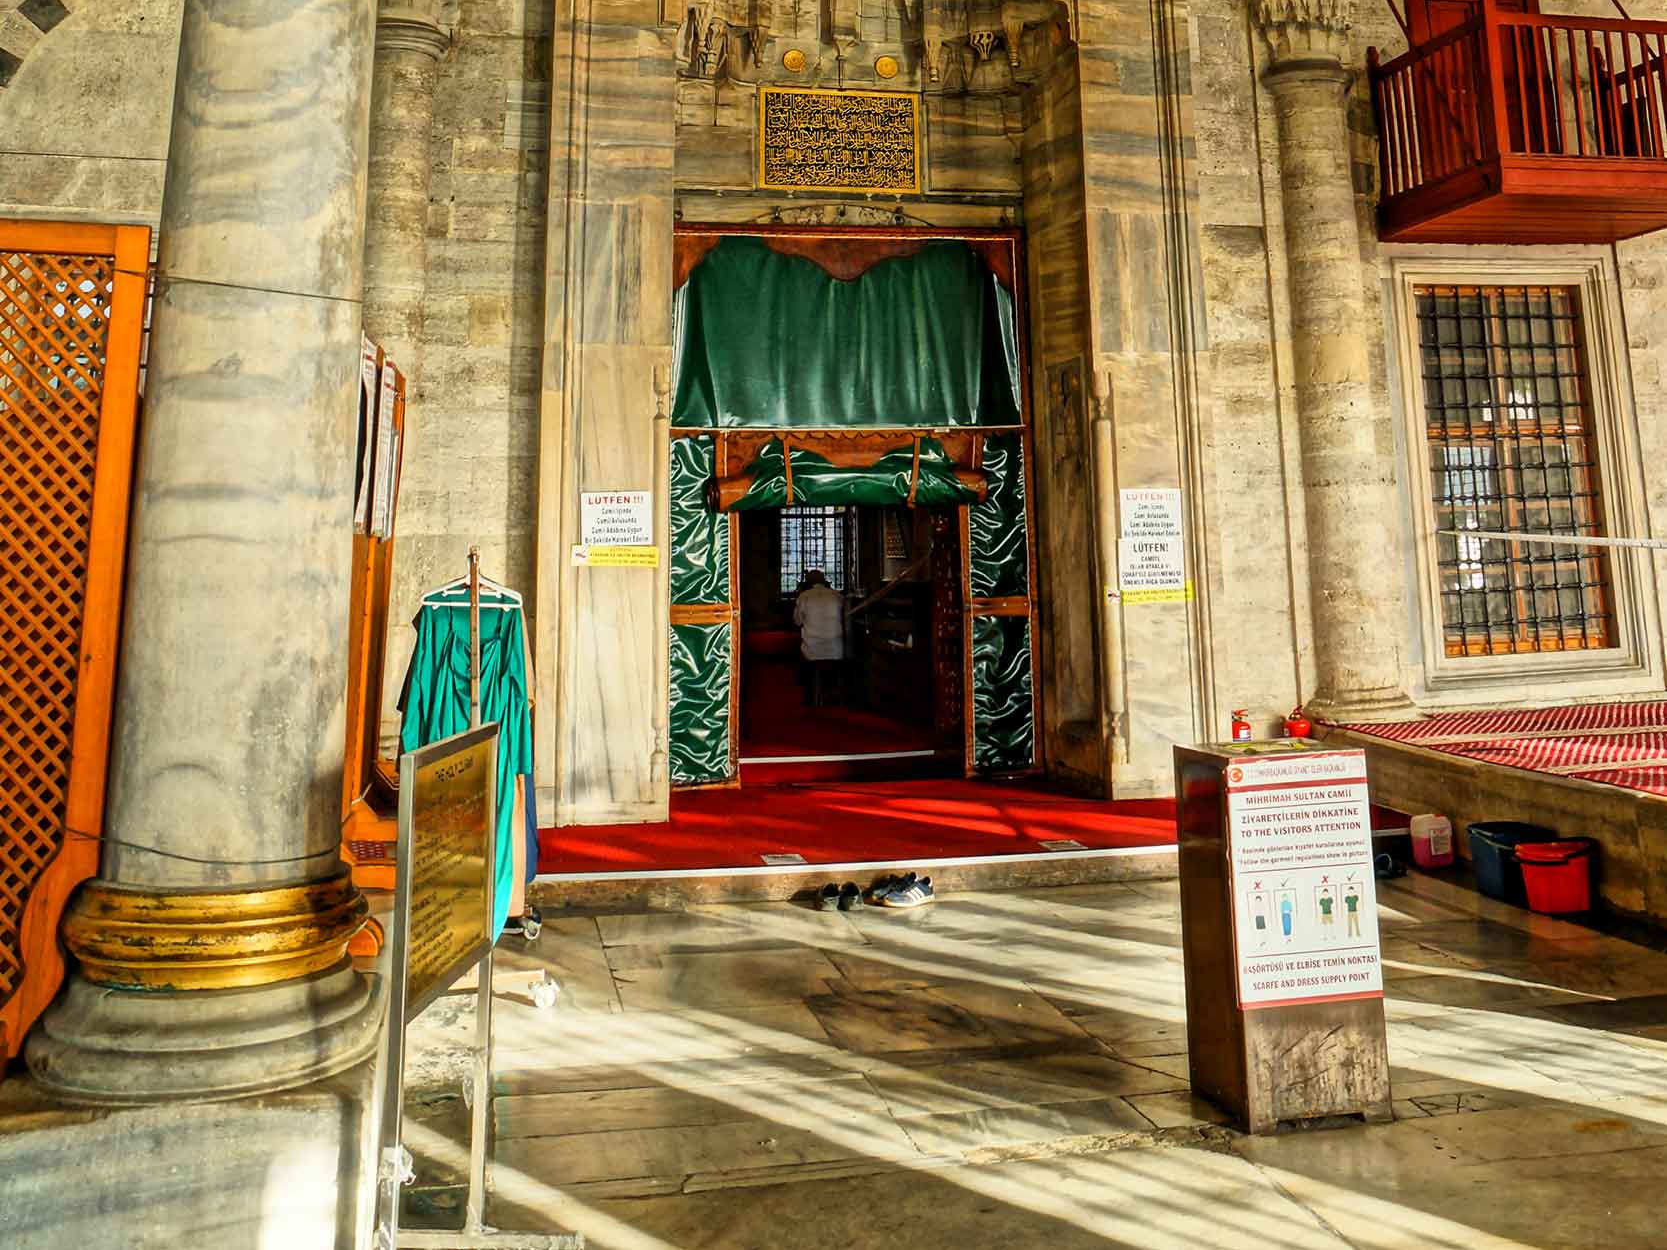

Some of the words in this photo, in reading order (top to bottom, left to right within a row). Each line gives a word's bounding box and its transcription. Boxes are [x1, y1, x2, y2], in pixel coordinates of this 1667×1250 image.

[1294, 791, 1325, 801] SULTAN
[1241, 829, 1252, 838] TO
[1255, 828, 1272, 837] THE
[1314, 821, 1362, 832] ATTENTION
[1347, 954, 1377, 965] NOKTASI
[1280, 979, 1296, 988] AND
[1297, 976, 1320, 986] DRESS
[1321, 974, 1347, 984] SUPPLY
[1348, 972, 1370, 982] POINT
